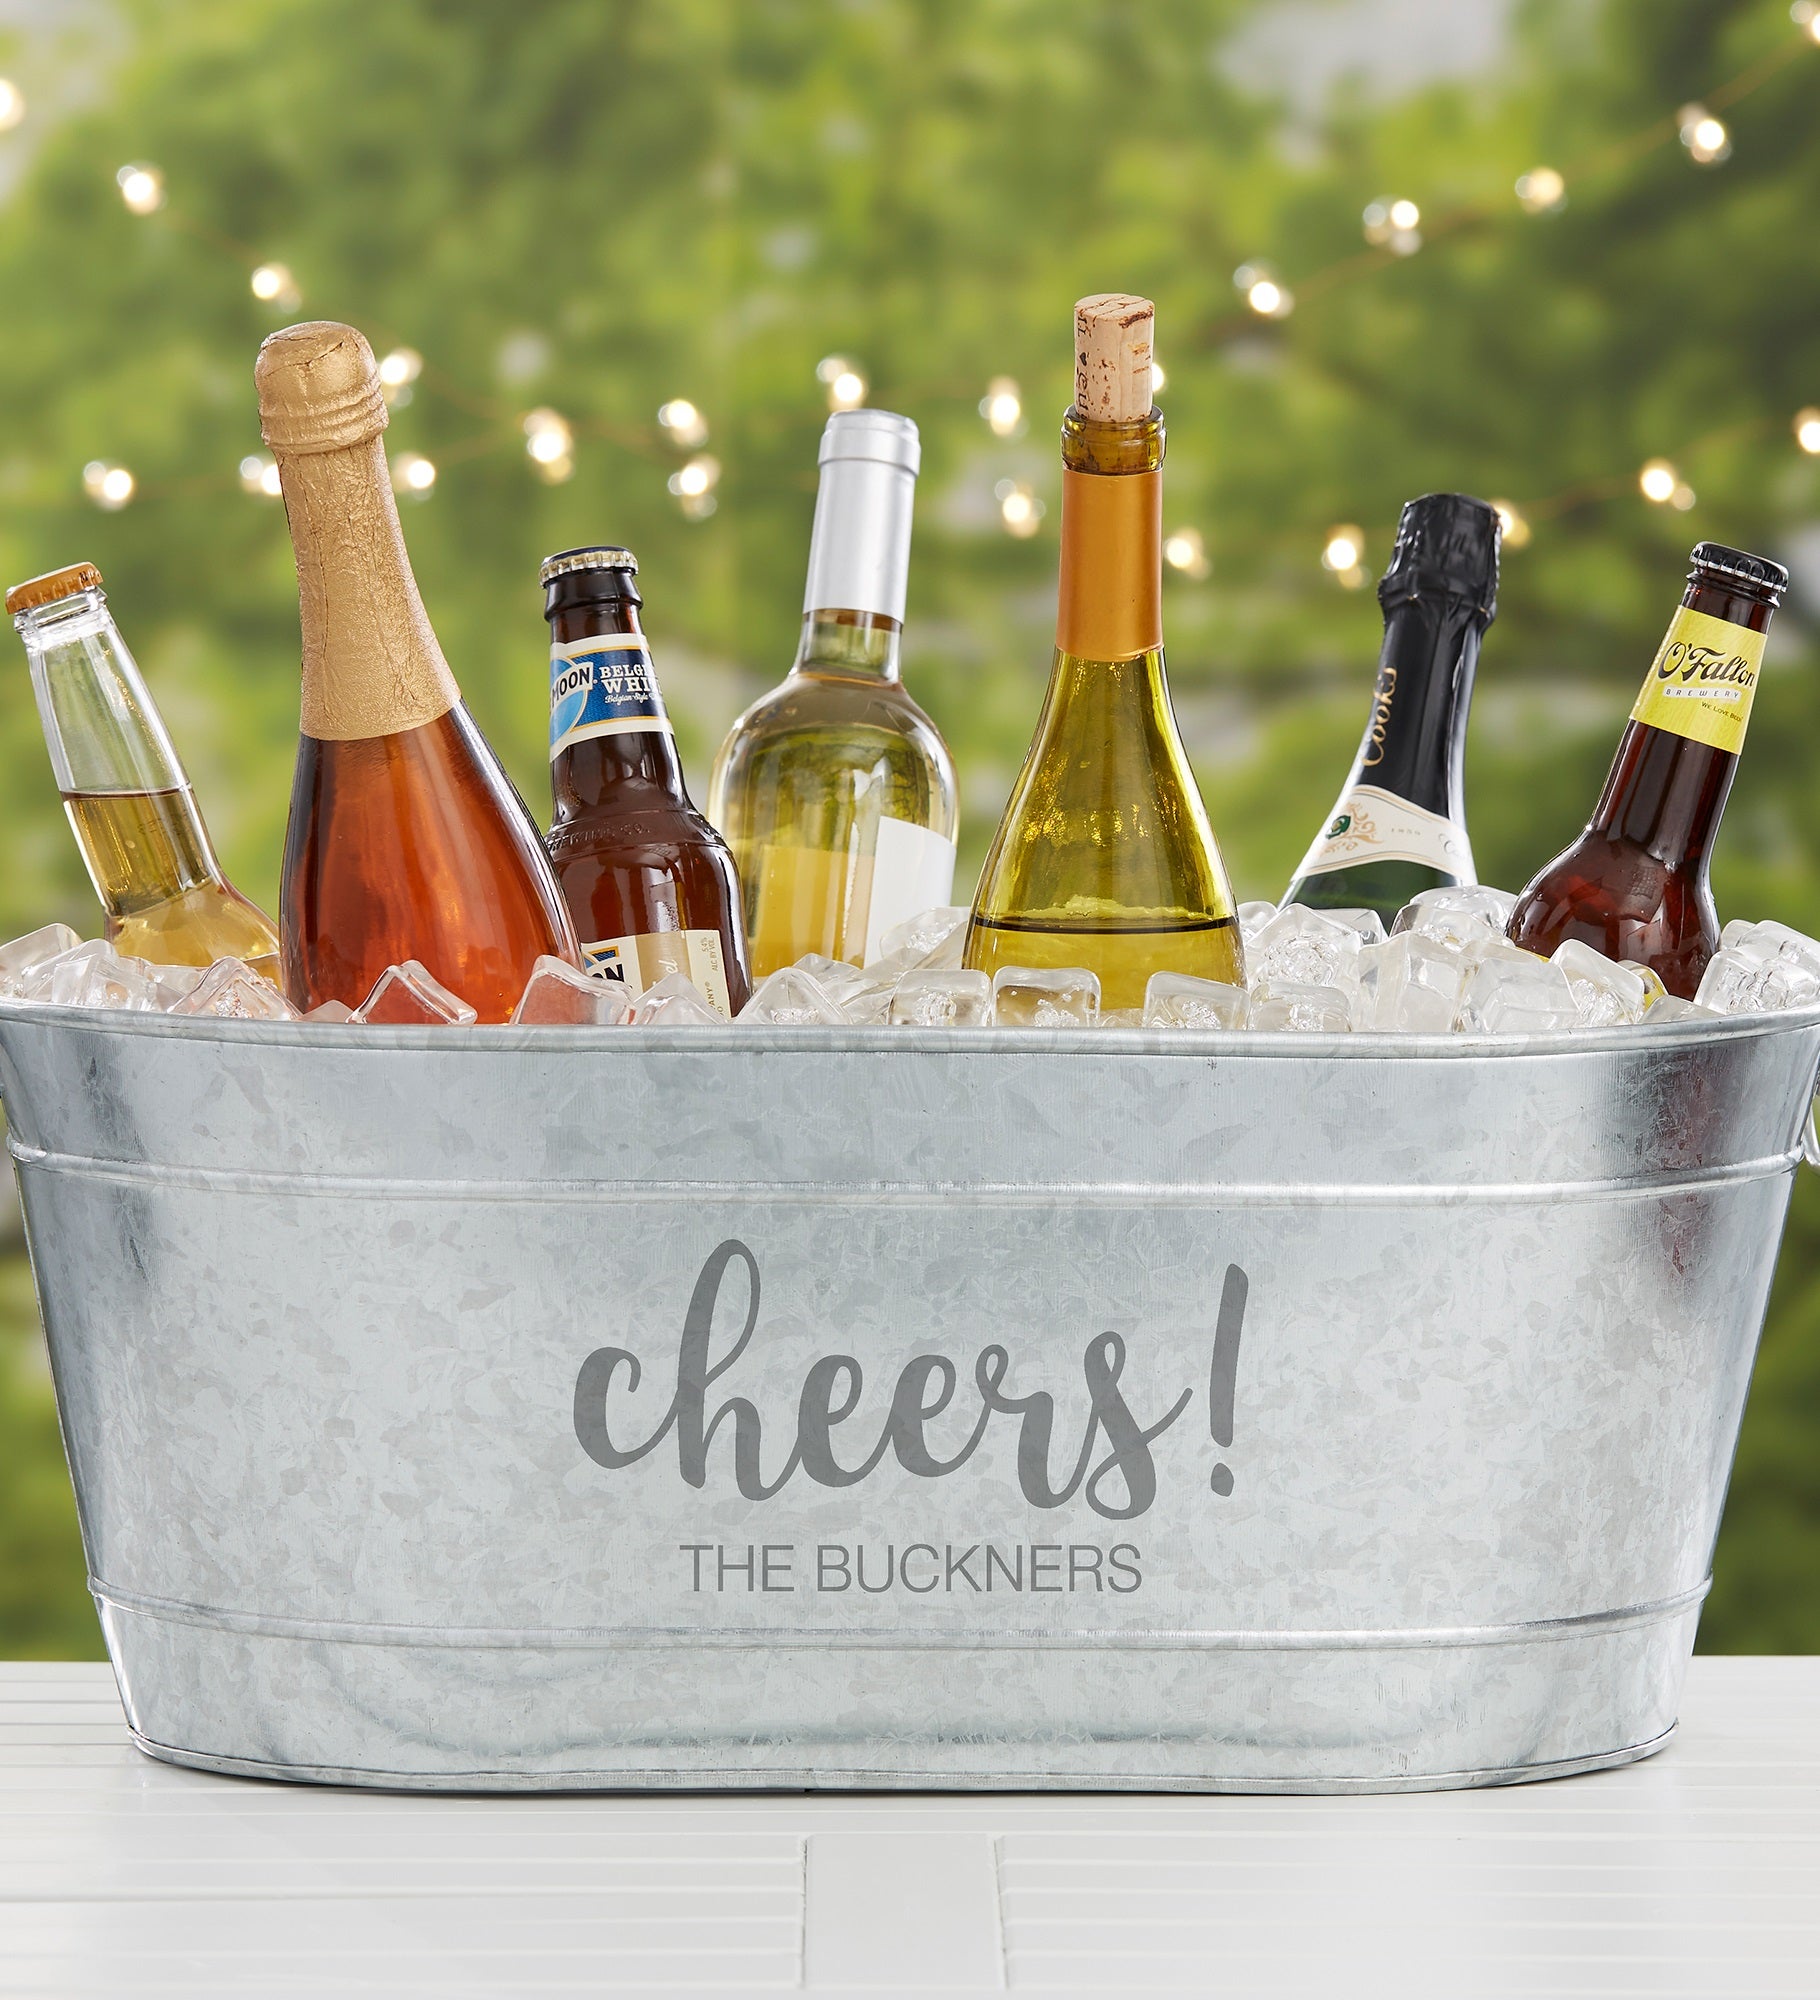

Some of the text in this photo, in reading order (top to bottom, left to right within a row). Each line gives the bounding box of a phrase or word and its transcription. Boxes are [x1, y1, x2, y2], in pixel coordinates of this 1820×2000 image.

[599, 664, 653, 679] BELGI
[1657, 641, 1756, 687] O'Fallon
[601, 676, 656, 694] WHI
[1665, 688, 1739, 698] BREWERY
[573, 1238, 1249, 1520] cheers!
[679, 1543, 1144, 1594] THE BUCKNERS
